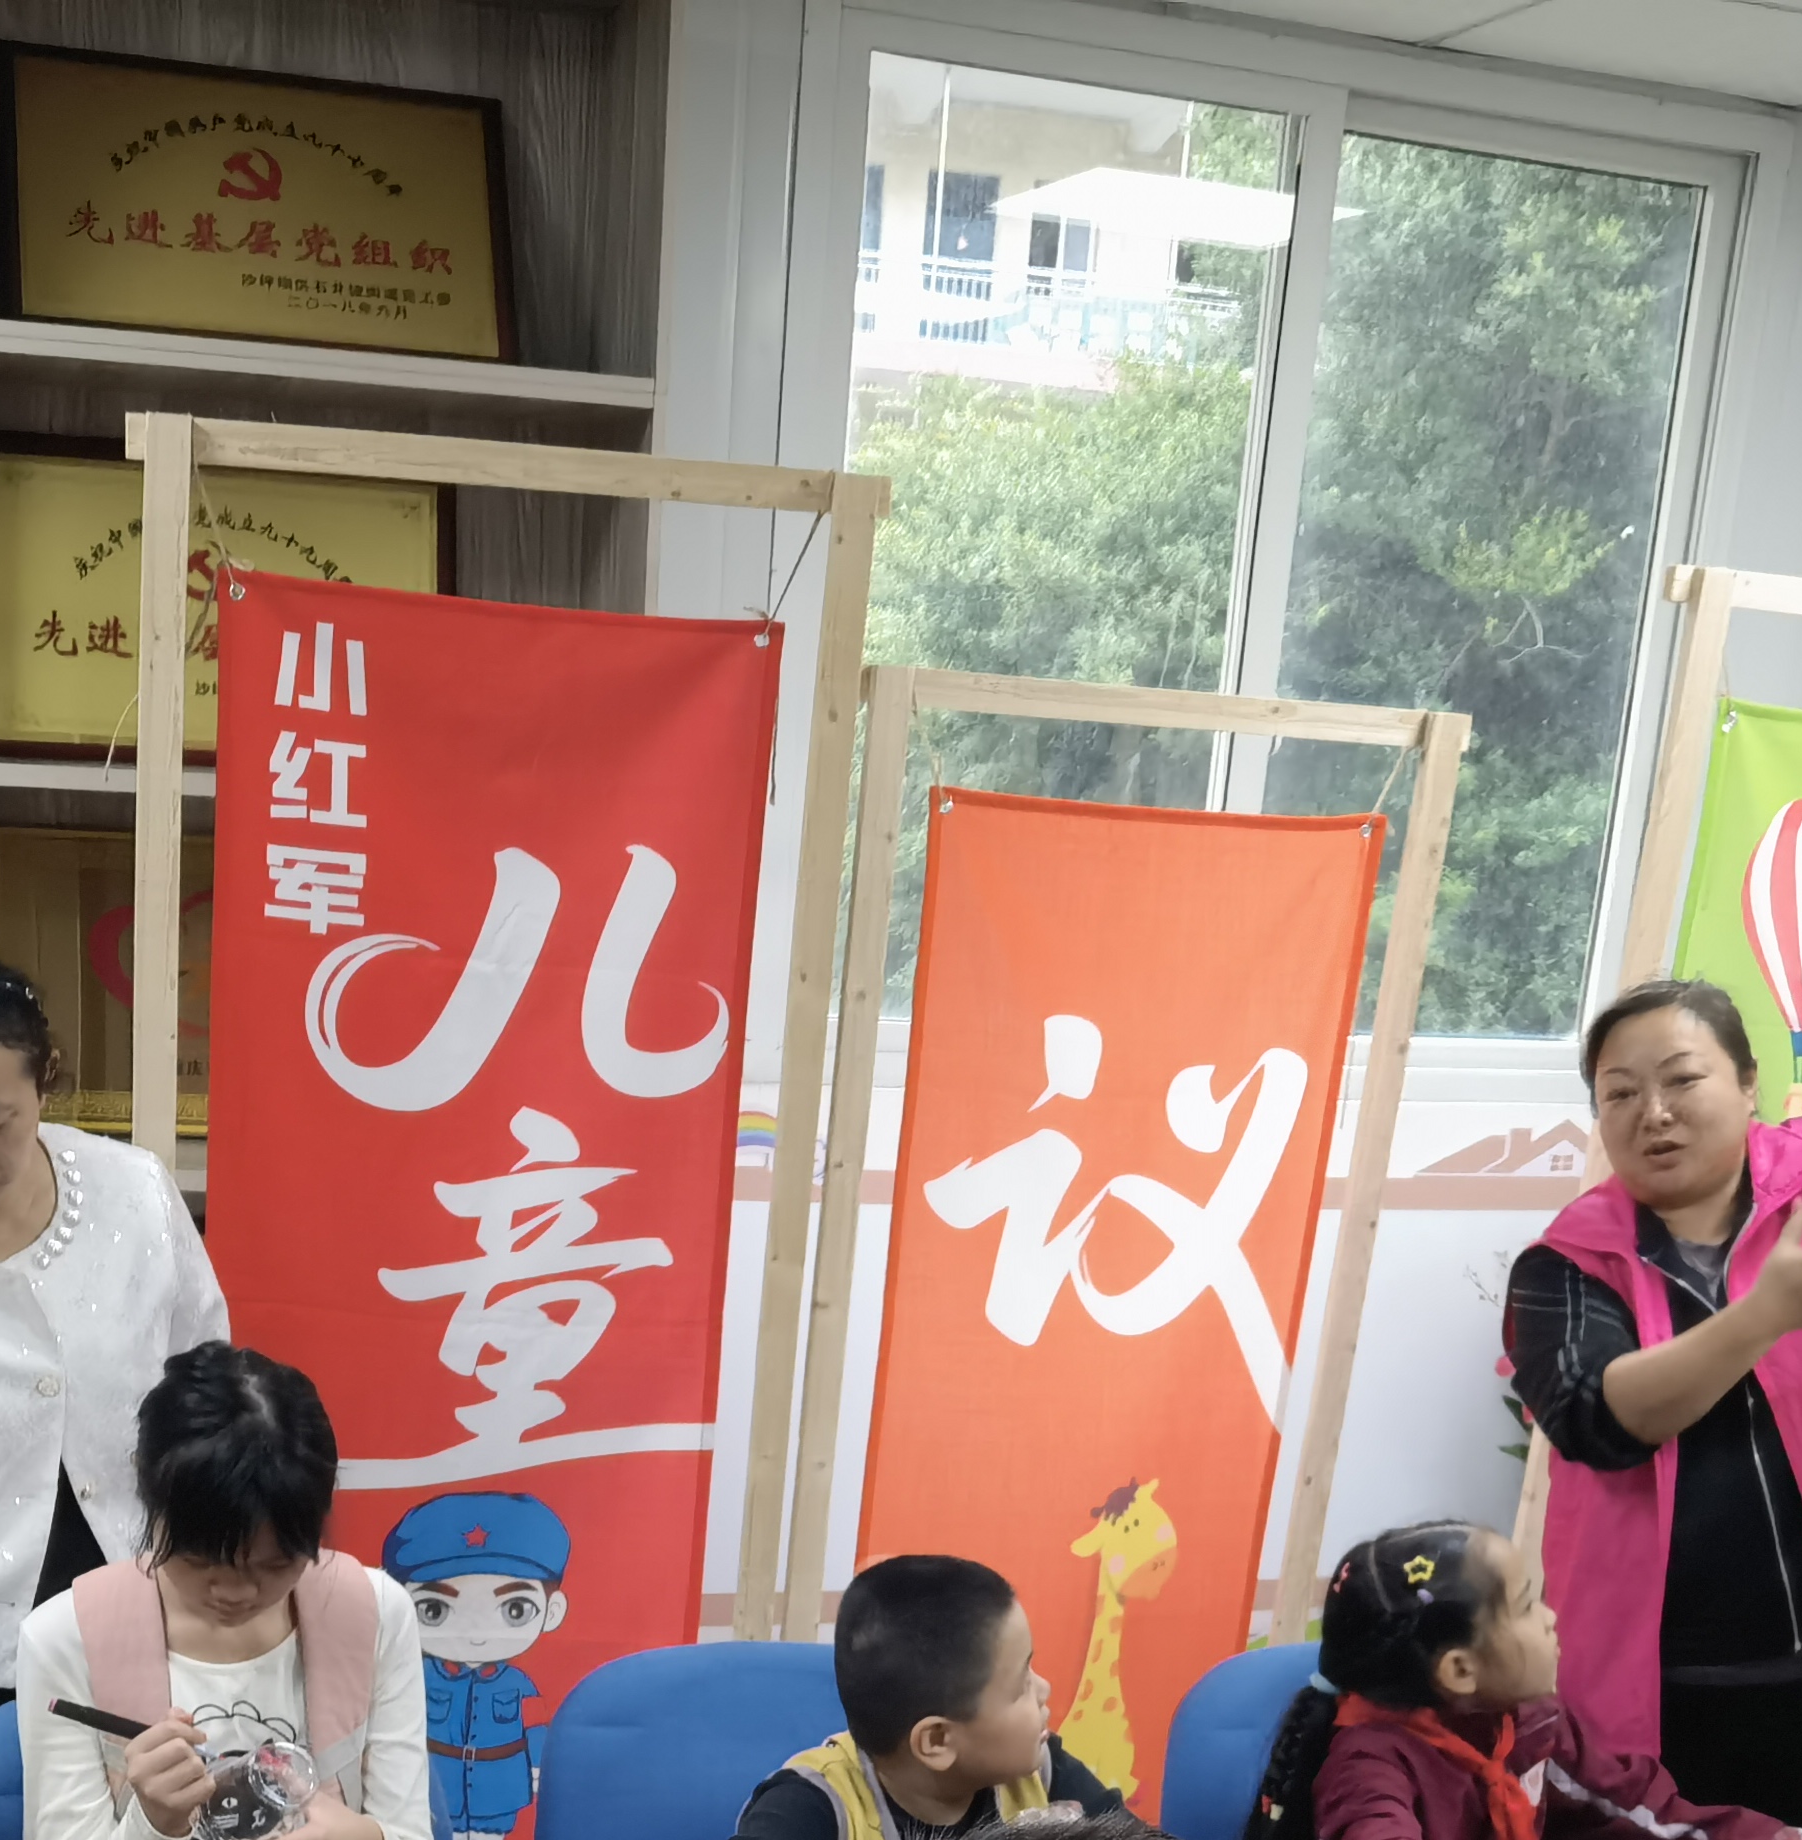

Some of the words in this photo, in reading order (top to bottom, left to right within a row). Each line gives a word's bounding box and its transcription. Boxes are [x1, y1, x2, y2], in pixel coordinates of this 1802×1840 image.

[66, 199, 455, 276] 先进基层党组织
[72, 503, 355, 584] 庆祝中国党成立九十九周
[263, 621, 368, 936] 小红军
[304, 844, 731, 1491] 儿童
[922, 1013, 1310, 1437] 议
